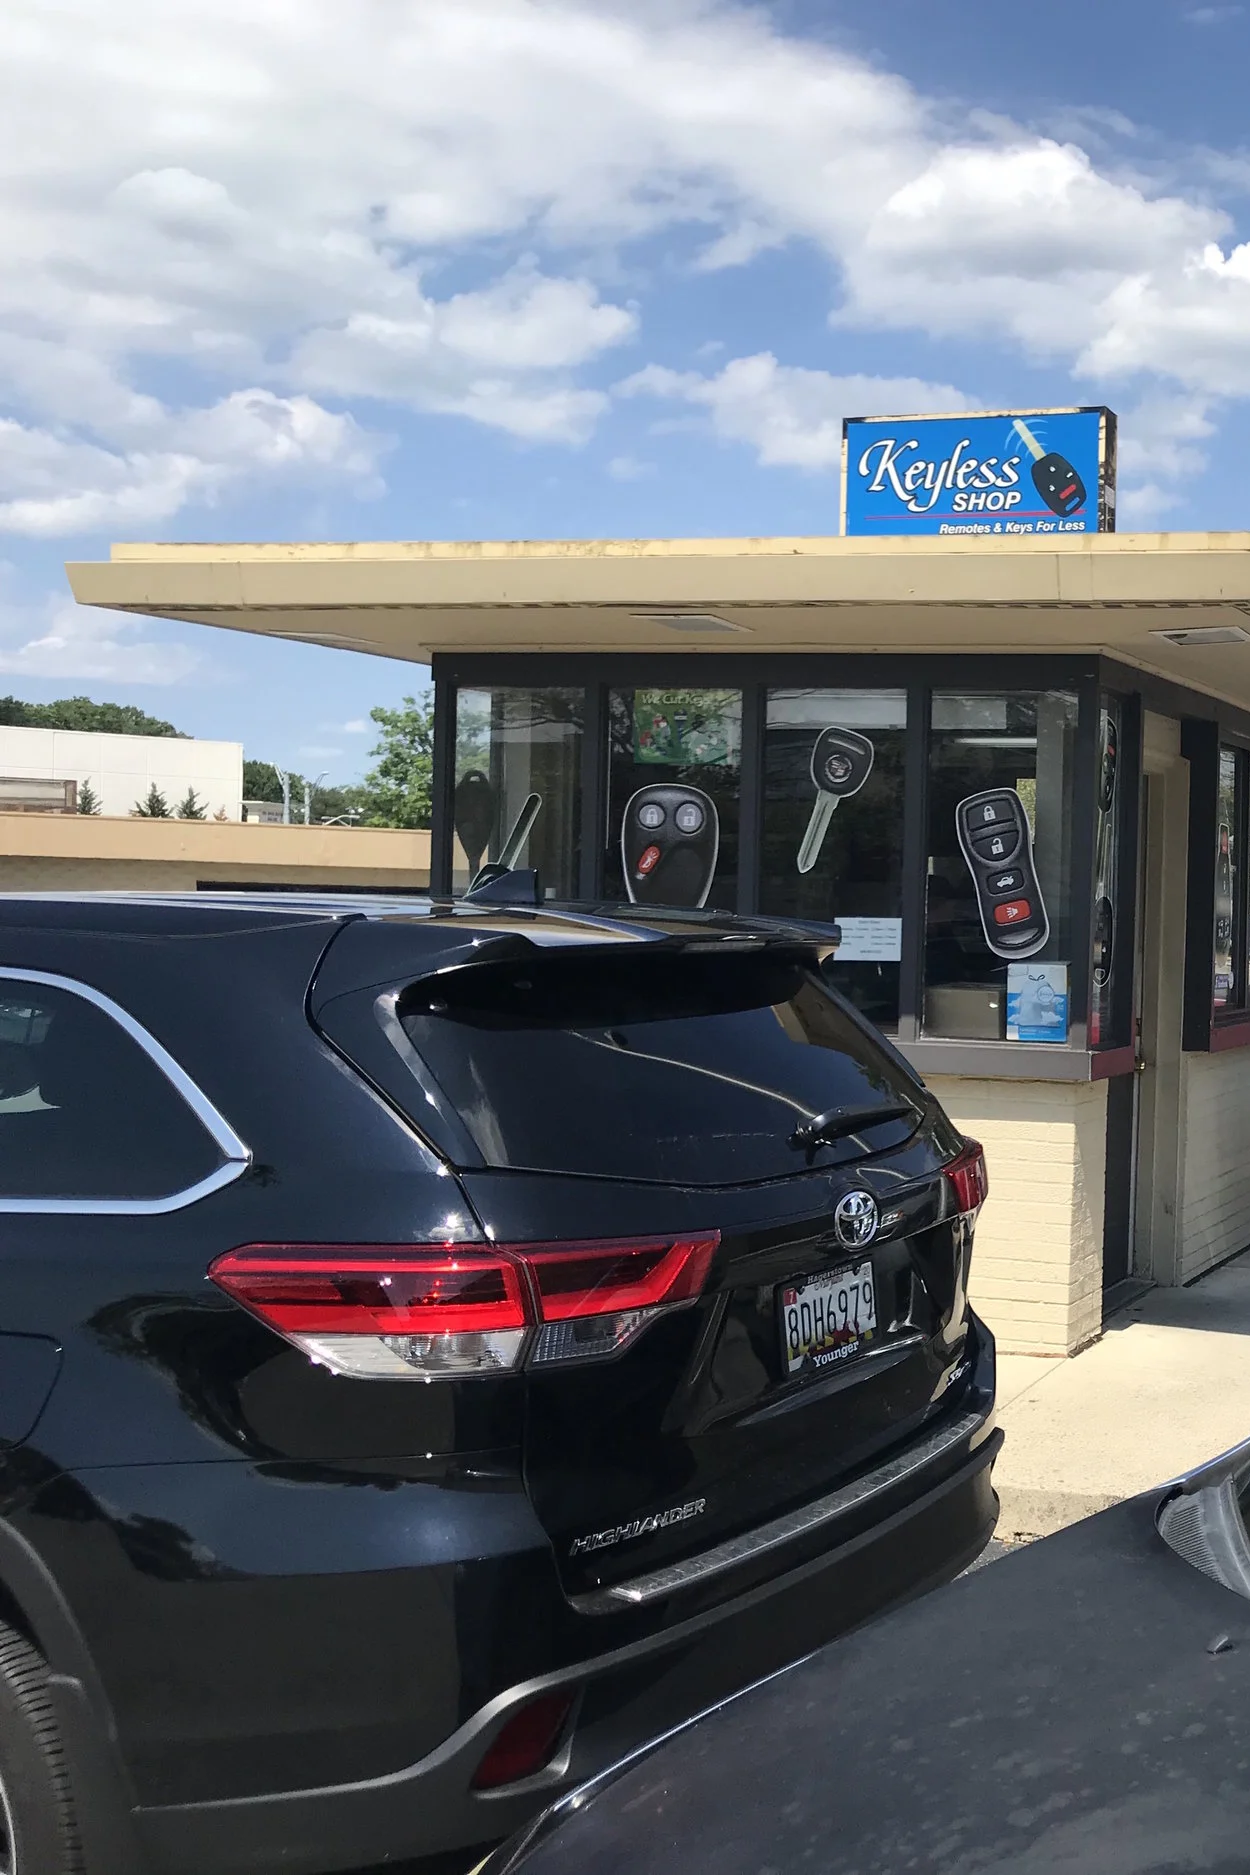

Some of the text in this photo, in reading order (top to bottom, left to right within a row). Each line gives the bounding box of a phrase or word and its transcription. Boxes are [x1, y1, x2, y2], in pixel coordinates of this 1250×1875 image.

[858, 438, 1022, 513] Keyless
[952, 491, 1022, 512] SHOP
[939, 520, 1085, 535] Remotes & Keys For Less
[642, 693, 660, 704] We
[663, 693, 684, 704] Cut
[788, 1280, 874, 1350] 8DH6979
[812, 1340, 860, 1367] Younger
[568, 1498, 706, 1556] HIGHLANDER
